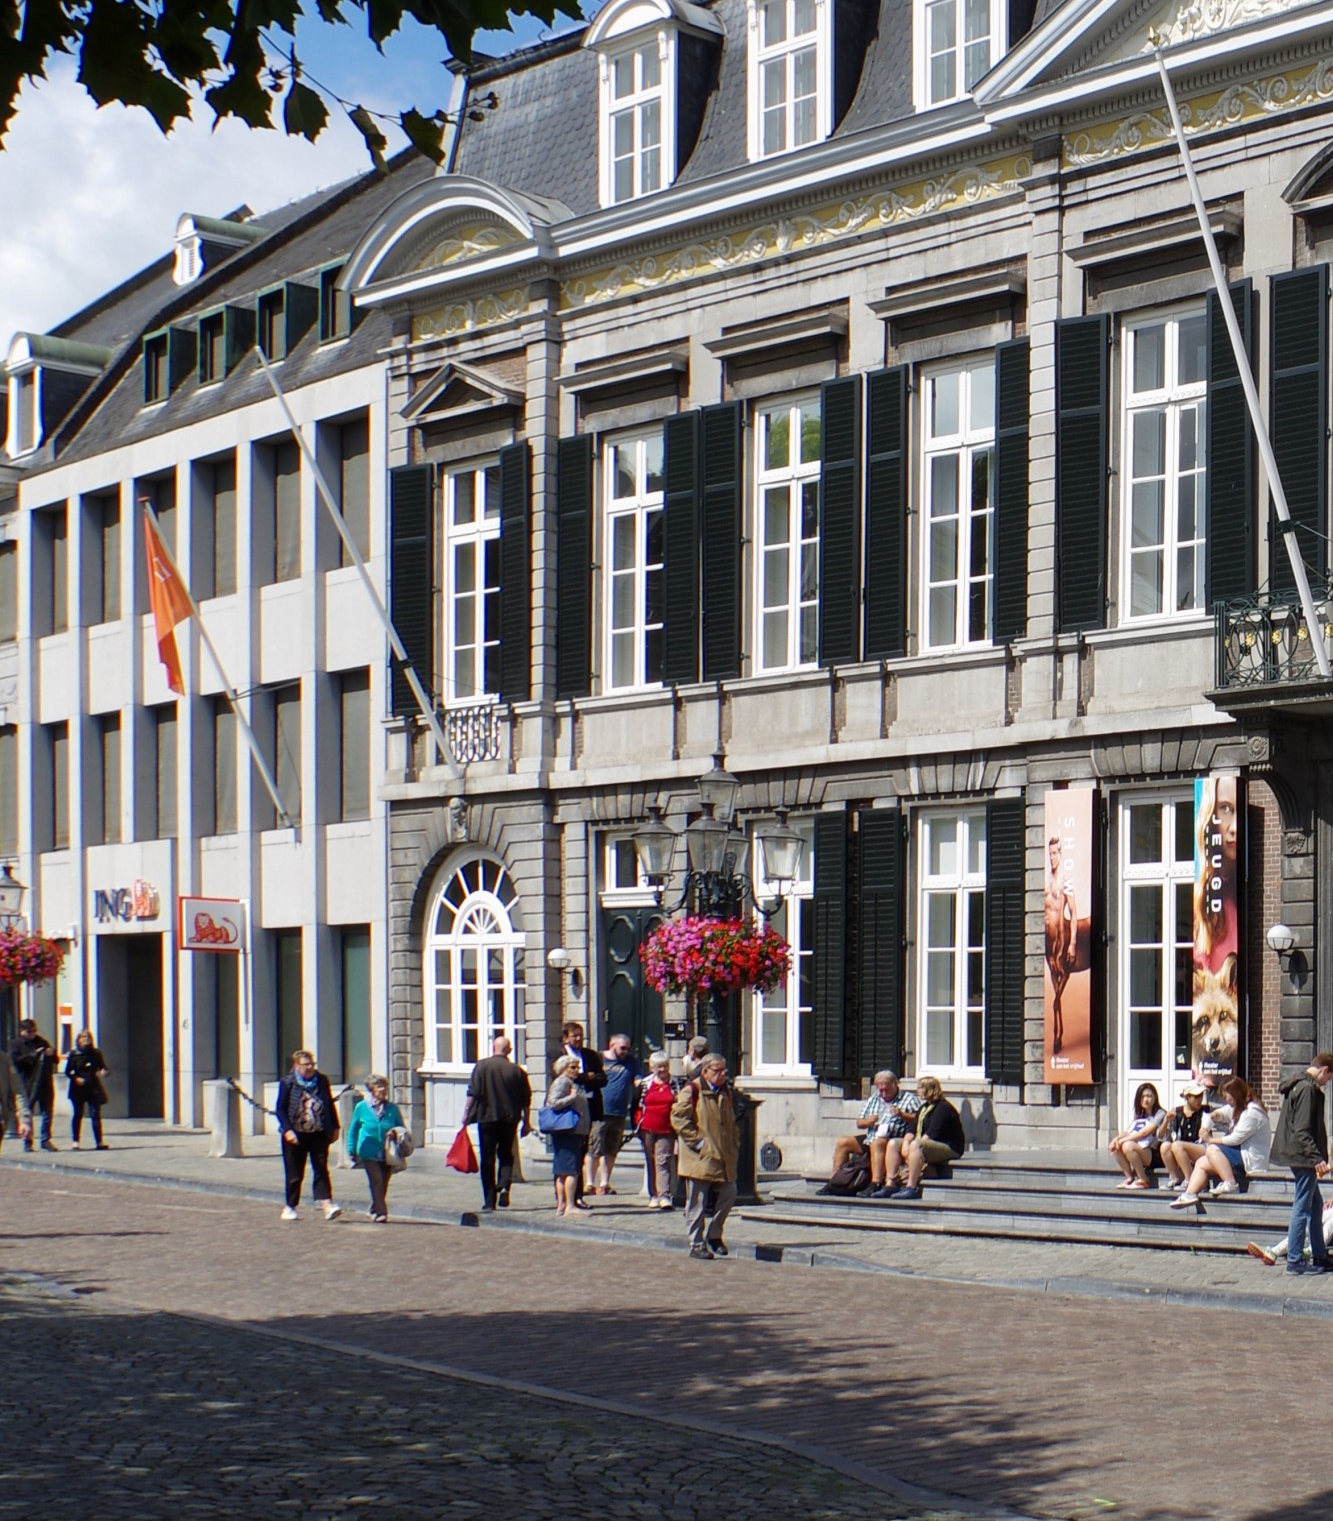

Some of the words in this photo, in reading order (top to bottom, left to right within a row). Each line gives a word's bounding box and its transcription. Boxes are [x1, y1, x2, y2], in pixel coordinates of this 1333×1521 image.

[1063, 816, 1075, 897] SHOW
[1211, 813, 1222, 913] JEUGD
[94, 887, 133, 922] ING
